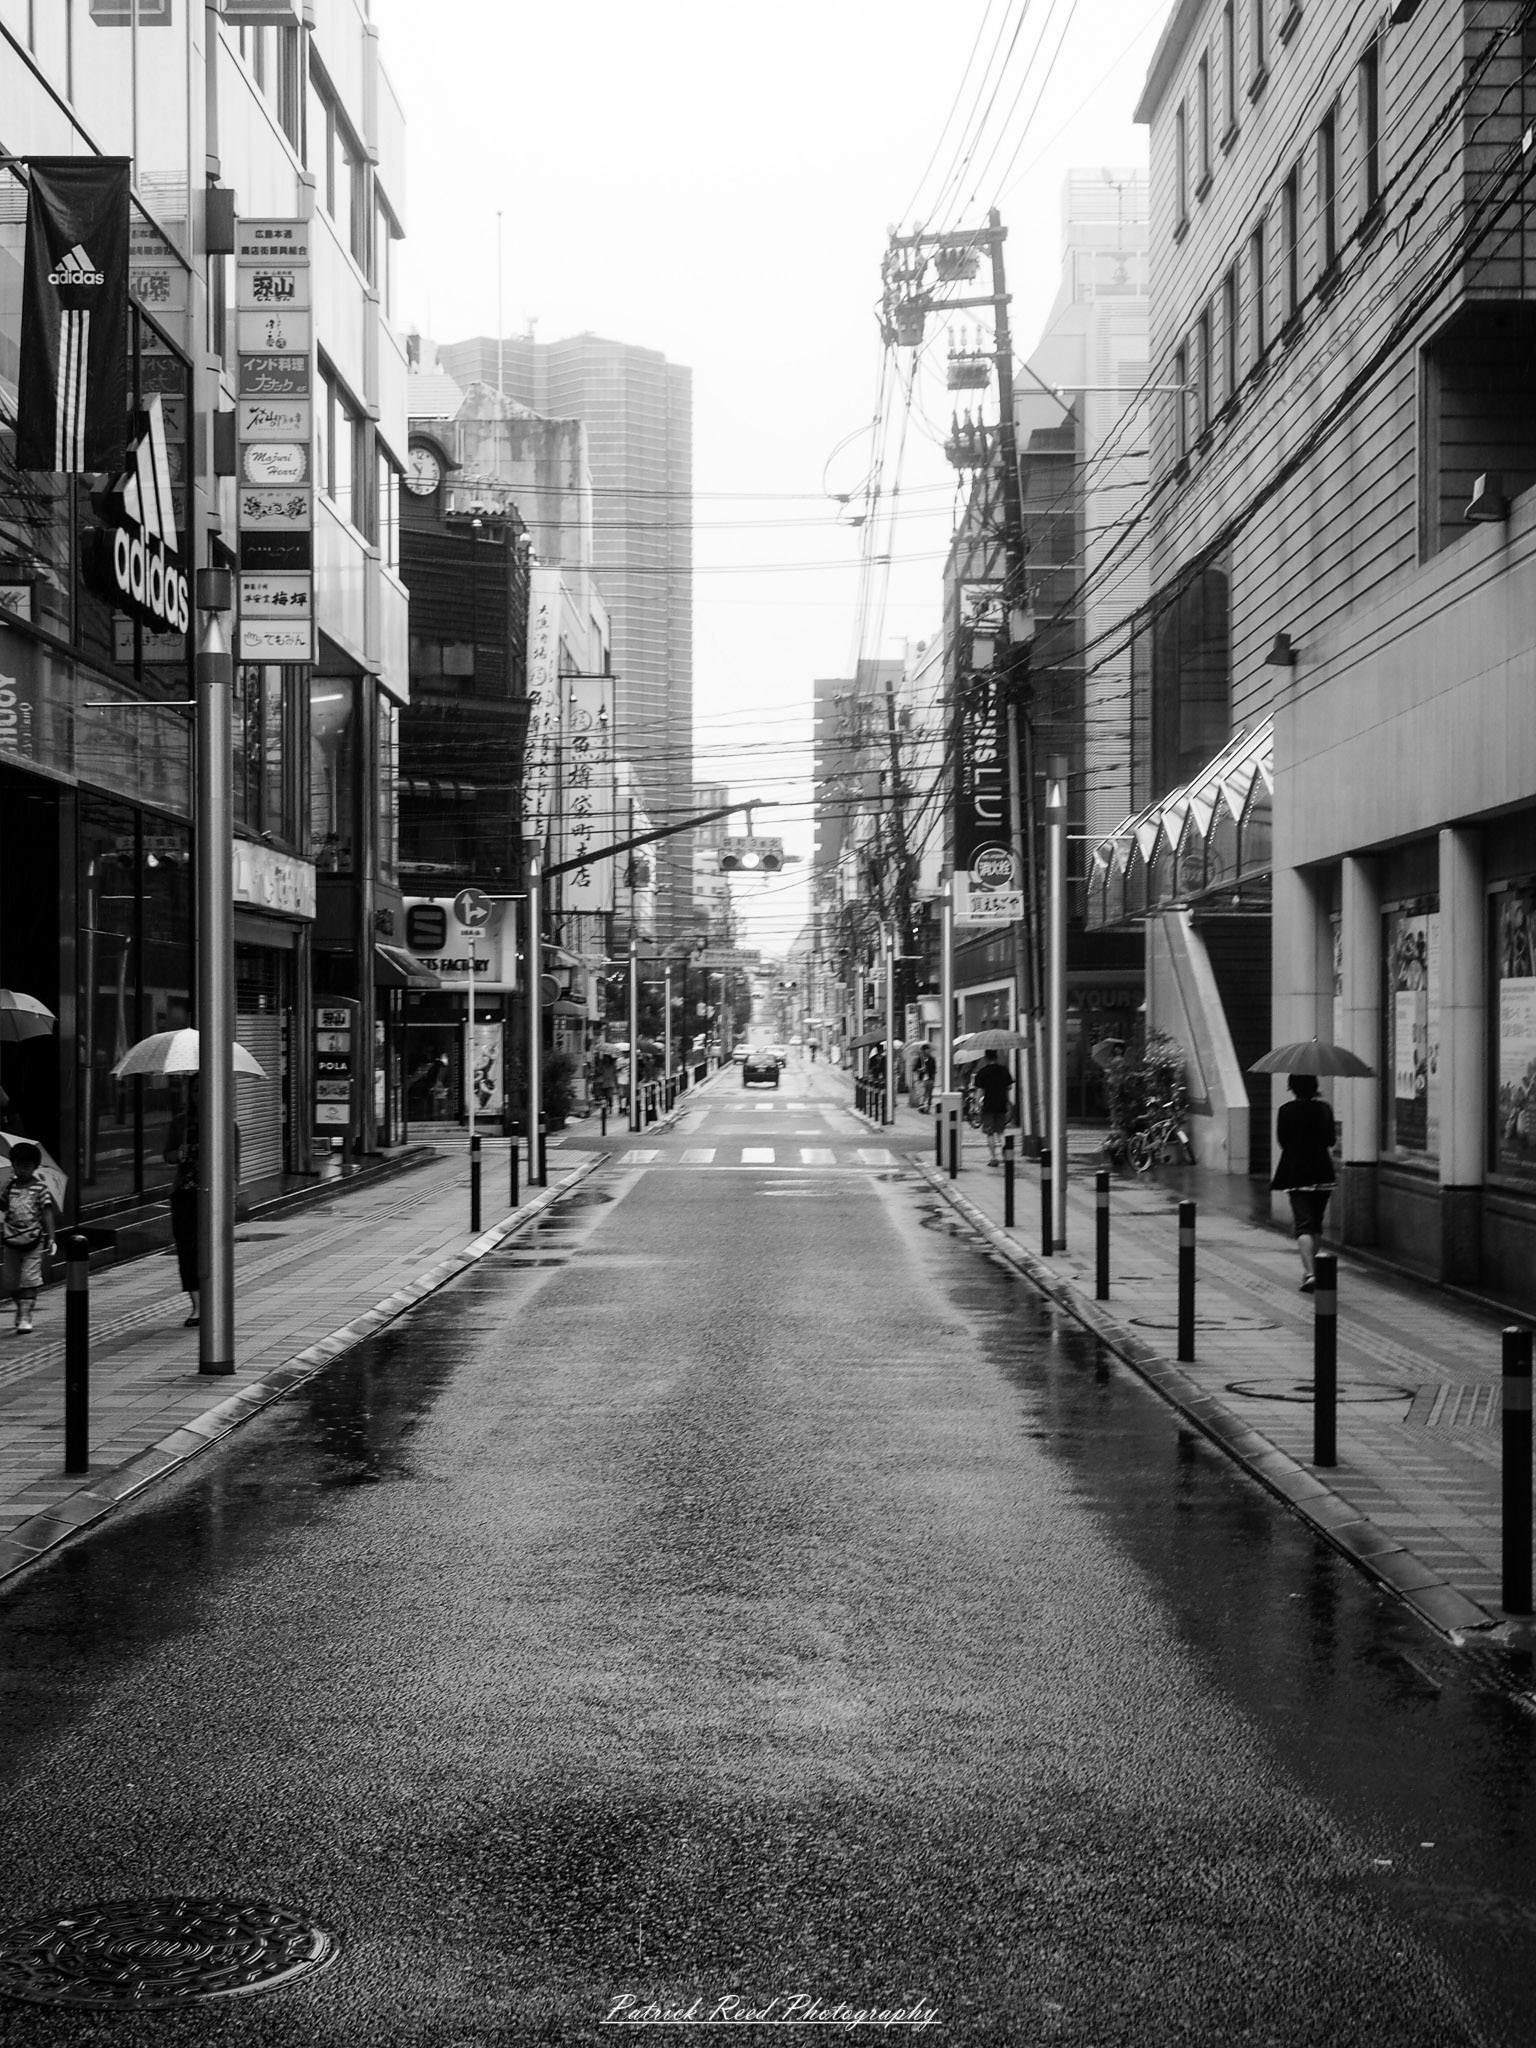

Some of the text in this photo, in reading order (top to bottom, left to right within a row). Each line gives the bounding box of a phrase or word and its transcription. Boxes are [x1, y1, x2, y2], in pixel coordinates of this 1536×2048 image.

[48, 270, 105, 285] adidas
[253, 276, 295, 297] 深山
[243, 357, 305, 371] インド料理
[266, 466, 298, 476] Heart
[114, 523, 189, 634] adidas
[978, 860, 1012, 877] 消火栓
[440, 958, 490, 972] FACTRY
[318, 1061, 349, 1071] POLA
